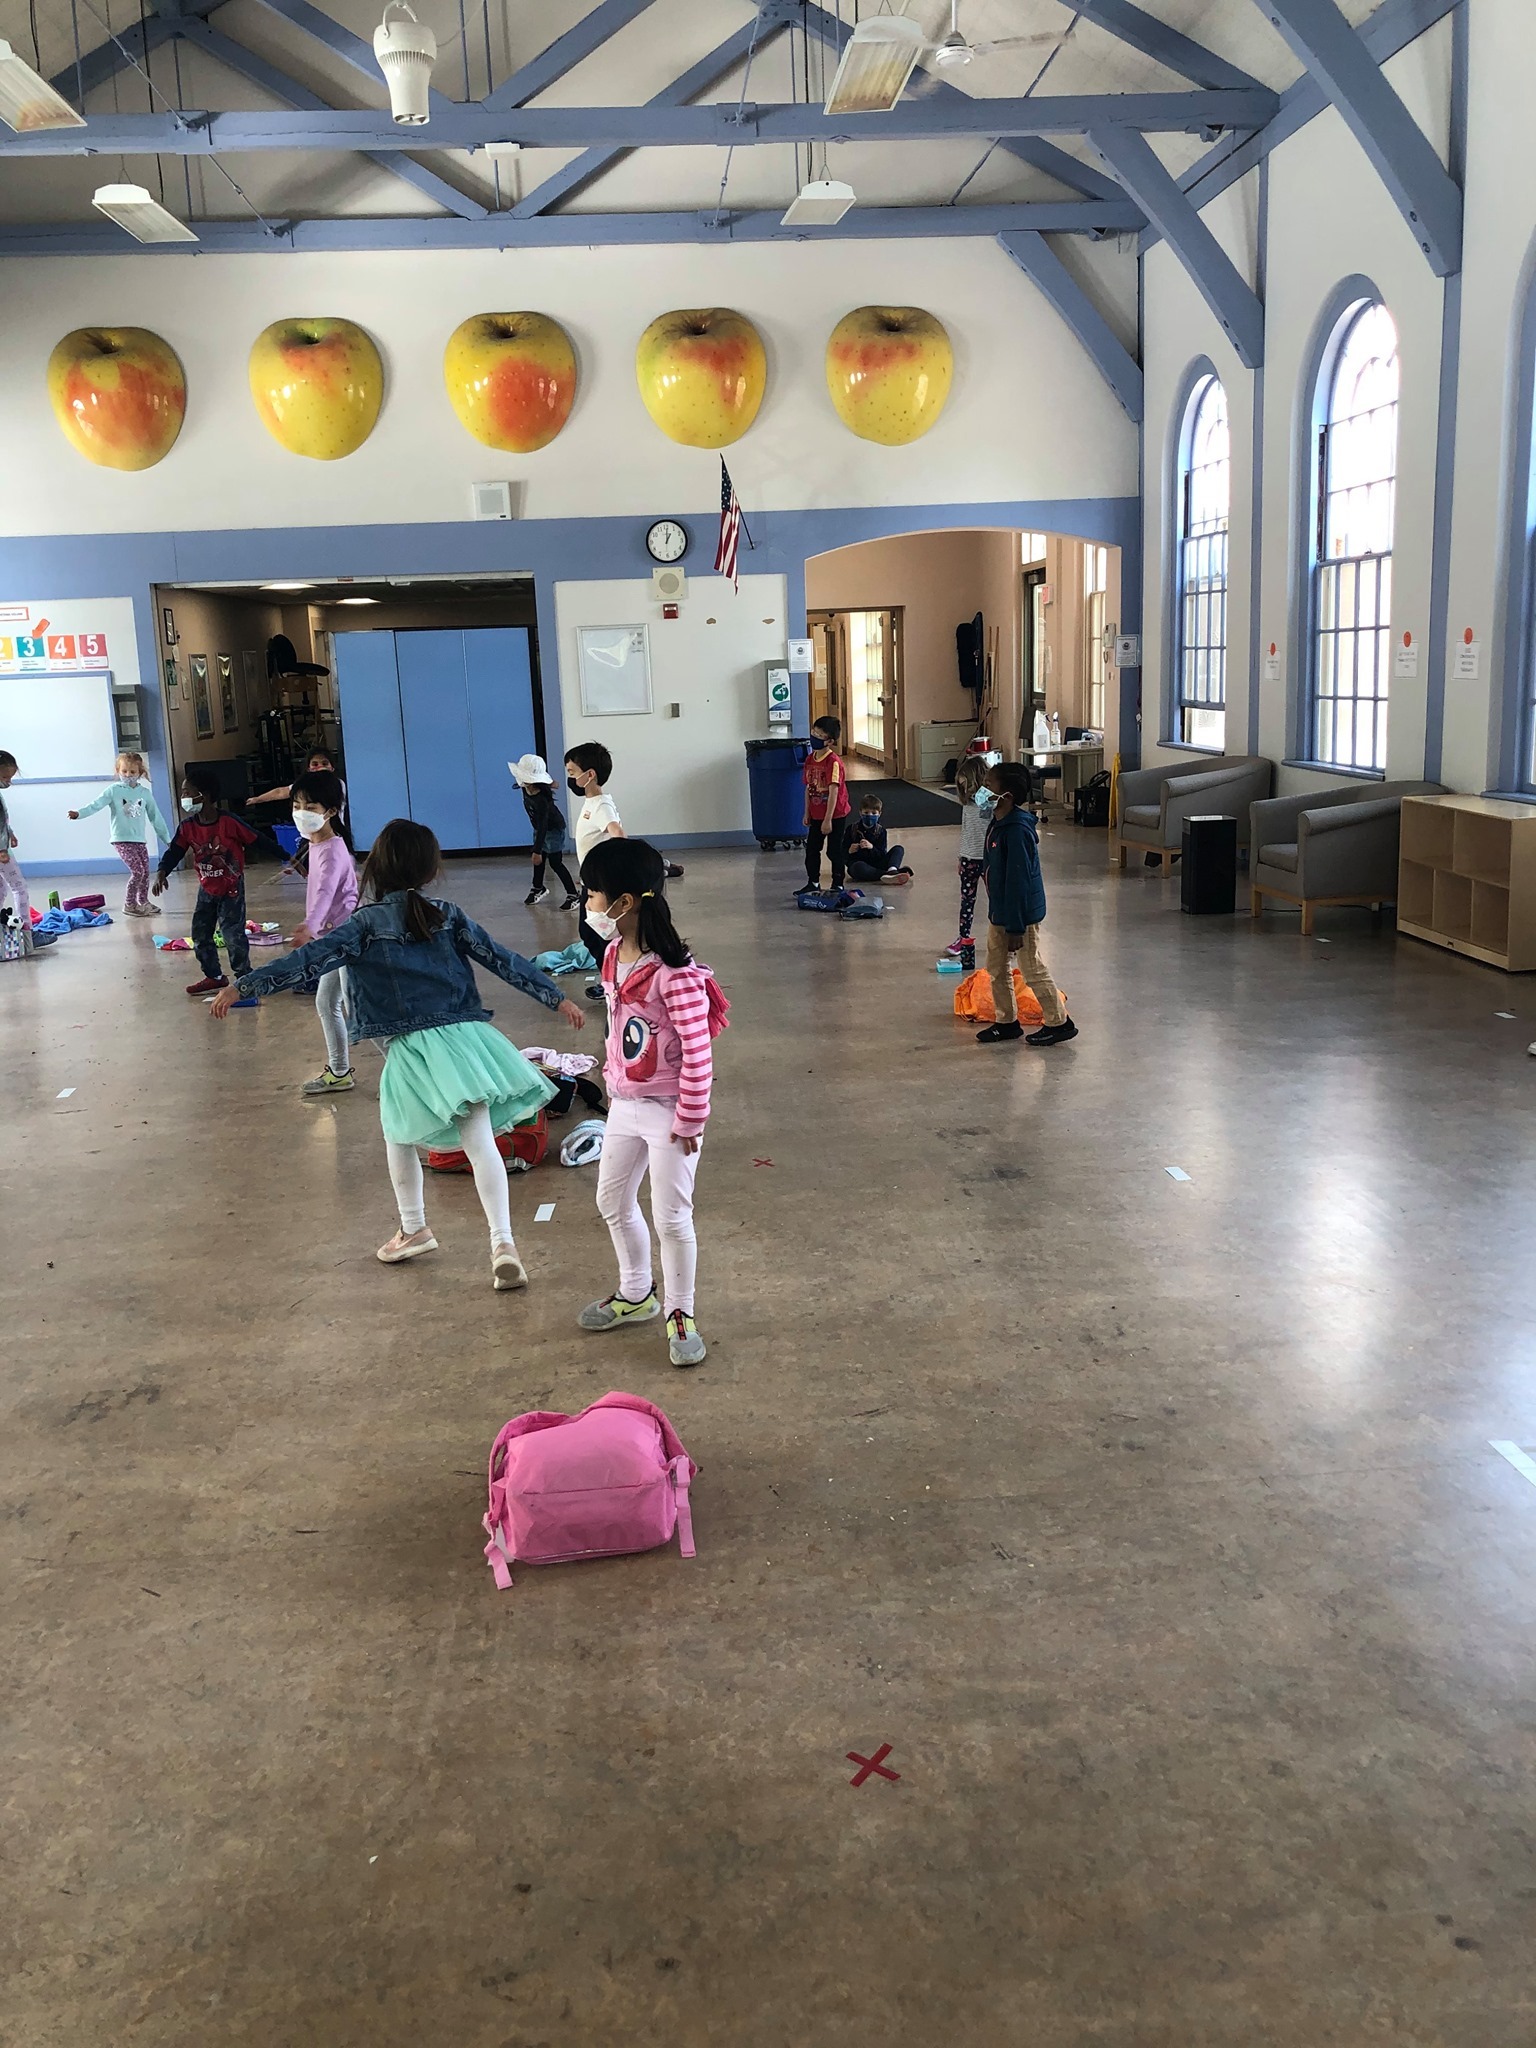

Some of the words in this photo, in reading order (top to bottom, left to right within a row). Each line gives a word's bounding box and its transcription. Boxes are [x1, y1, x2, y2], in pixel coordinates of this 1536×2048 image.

[22, 636, 36, 657] 3
[54, 636, 67, 657] 4
[86, 634, 99, 655] 5
